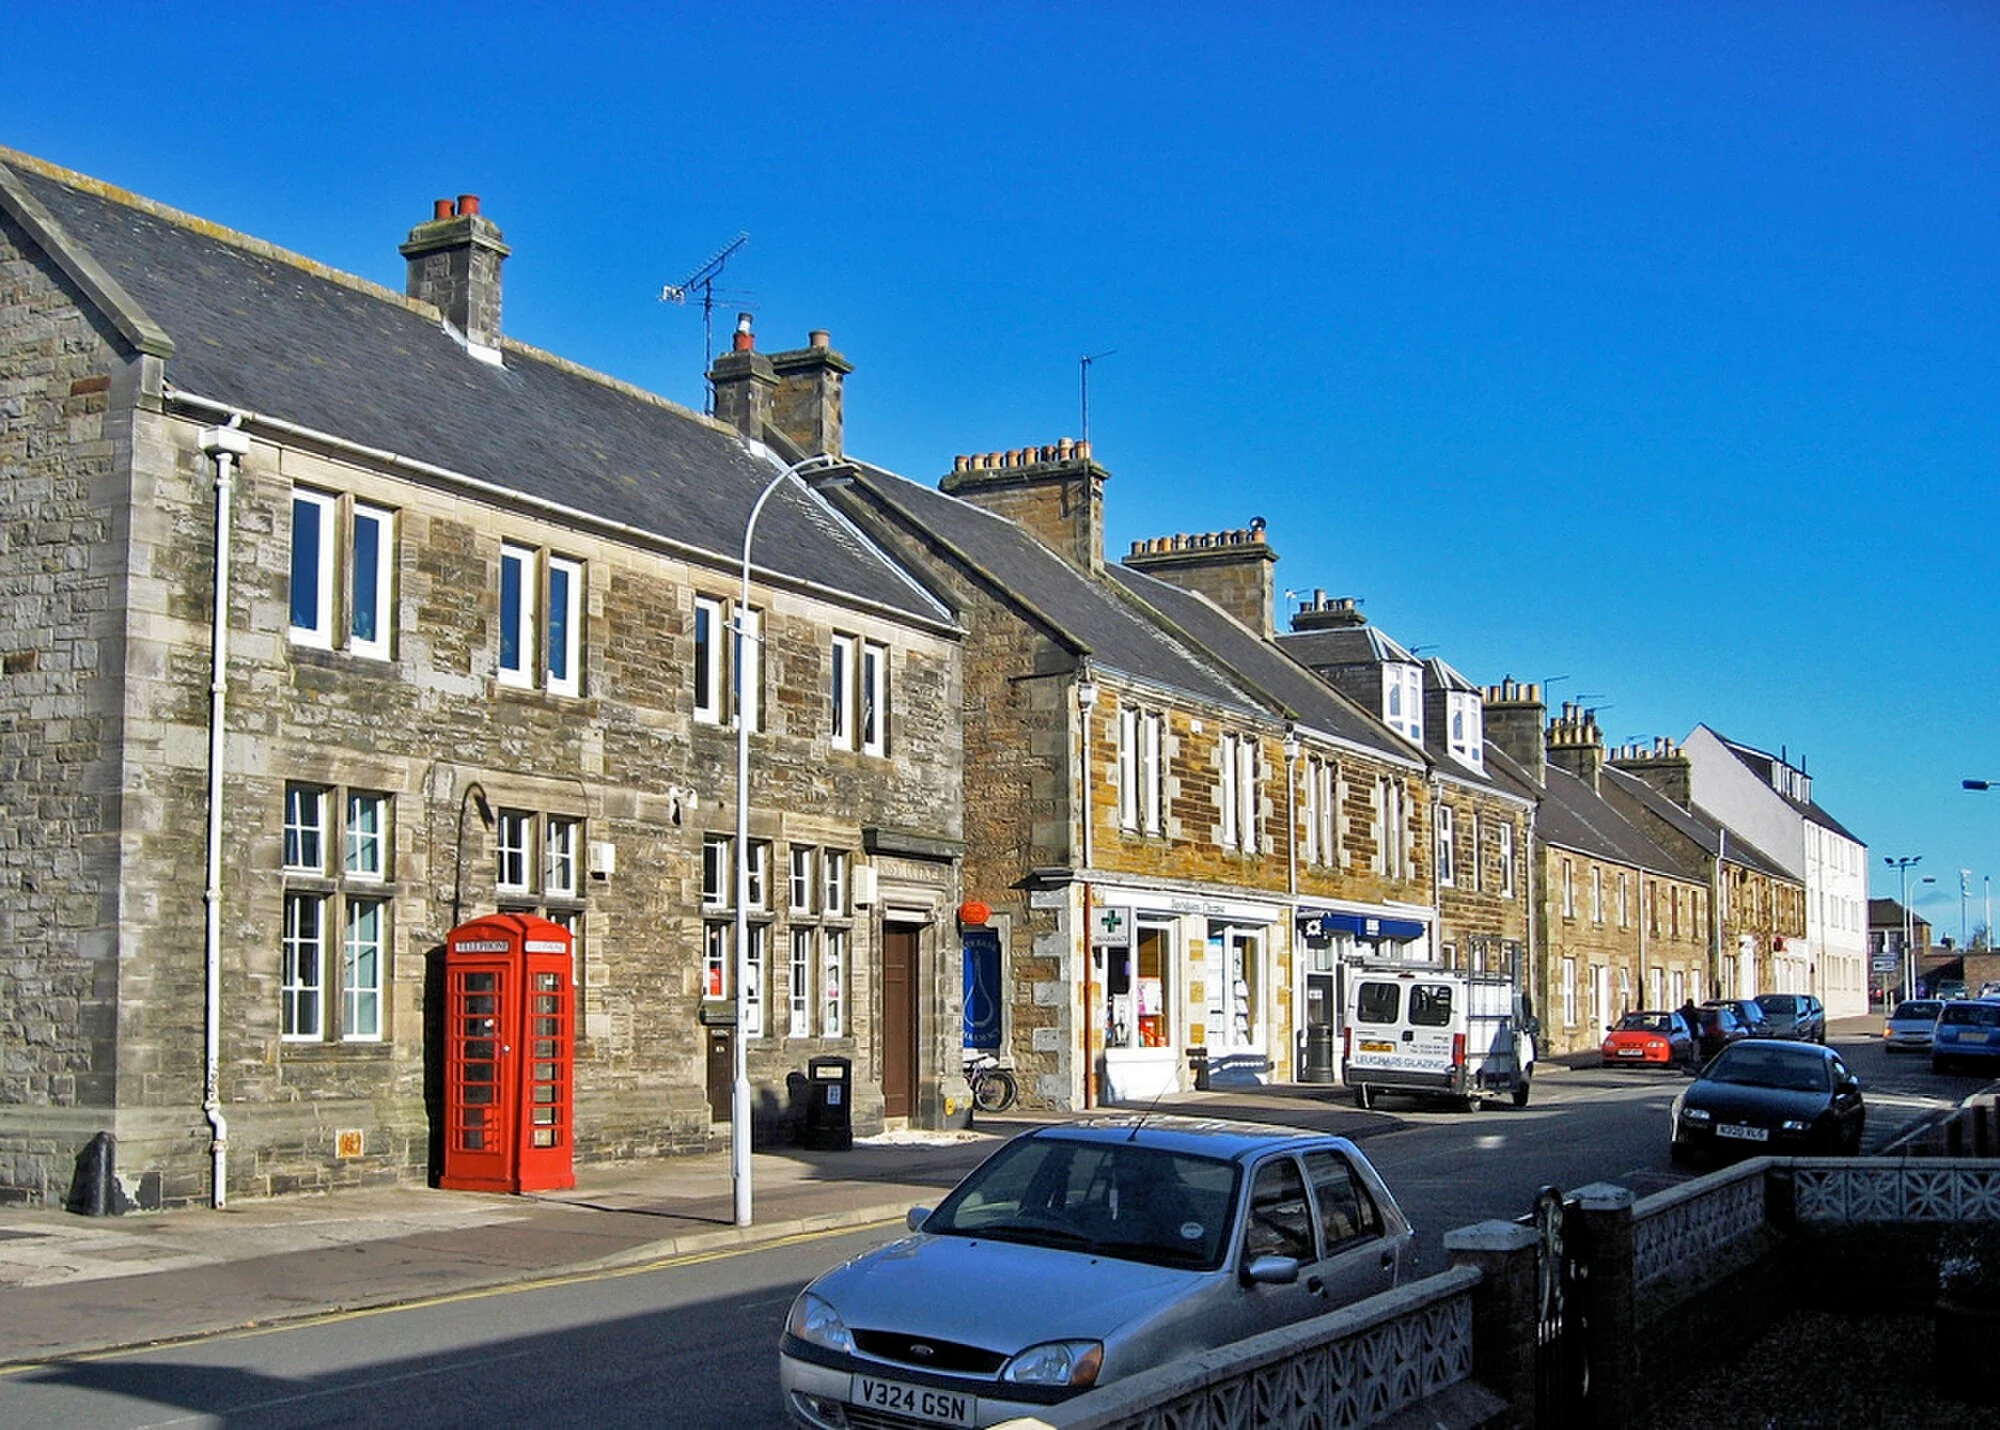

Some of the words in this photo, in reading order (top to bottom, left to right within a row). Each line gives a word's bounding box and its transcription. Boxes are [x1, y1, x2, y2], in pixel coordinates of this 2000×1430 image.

[456, 941, 508, 952] TELEPHONE
[863, 1380, 915, 1411] V324
[921, 1392, 966, 1422] GSN
